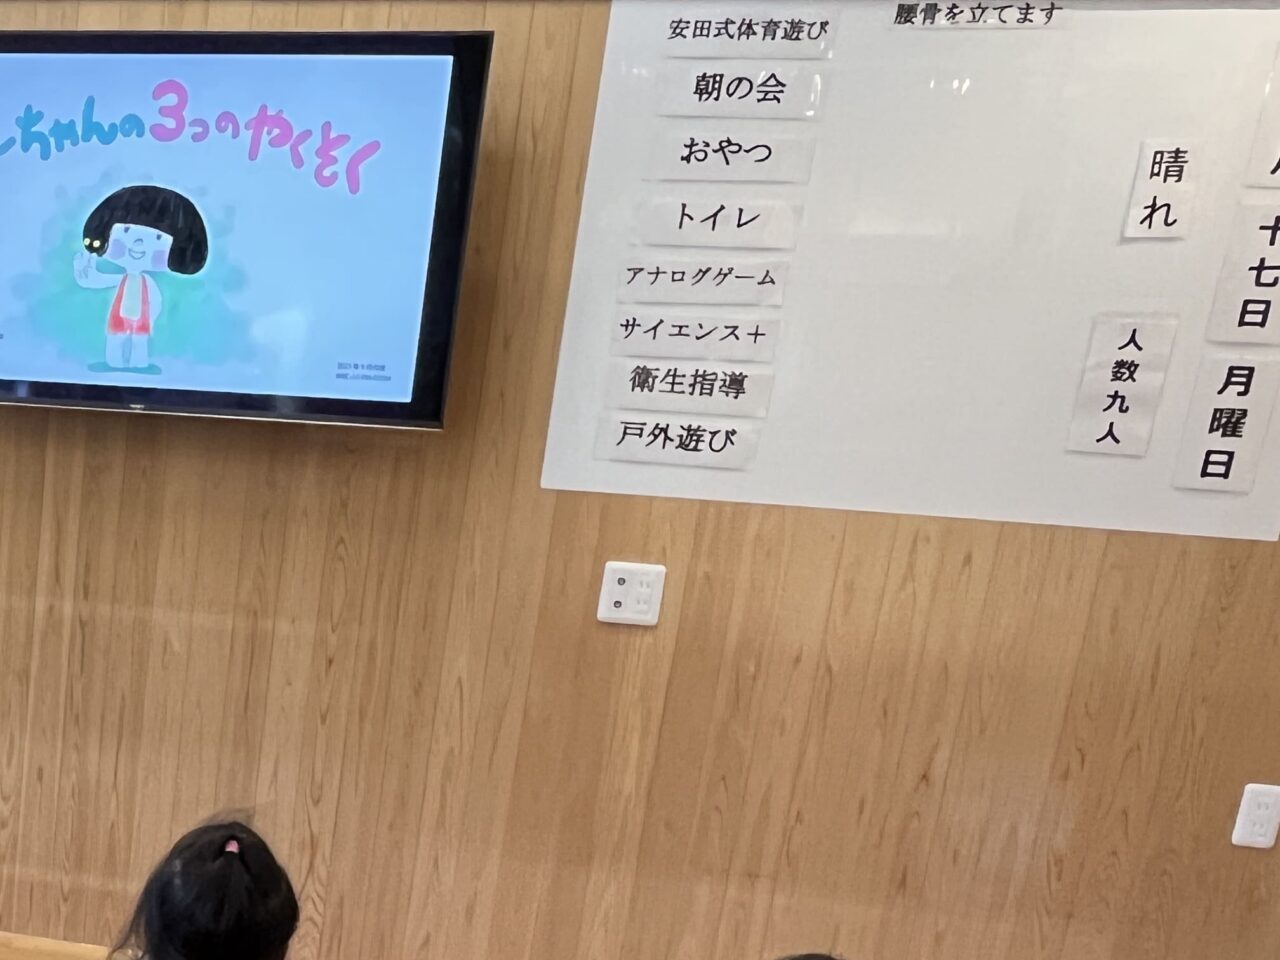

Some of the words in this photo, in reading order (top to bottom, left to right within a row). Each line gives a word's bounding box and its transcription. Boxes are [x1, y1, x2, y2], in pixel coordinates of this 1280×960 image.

[668, 18, 829, 42] 安田式体育遊び
[894, 3, 1063, 26] 腰骨を立てます
[693, 72, 787, 104] 朝の会
[680, 137, 772, 165] おやつ
[1139, 148, 1189, 230] 晴れ
[677, 203, 761, 232] トイレ
[626, 266, 777, 287] アナログゲーム
[629, 364, 747, 400] 衛生指導
[1095, 328, 1144, 445] 人数九人
[616, 420, 738, 453] 戸外遊び
[1200, 365, 1256, 480] 月曜日
